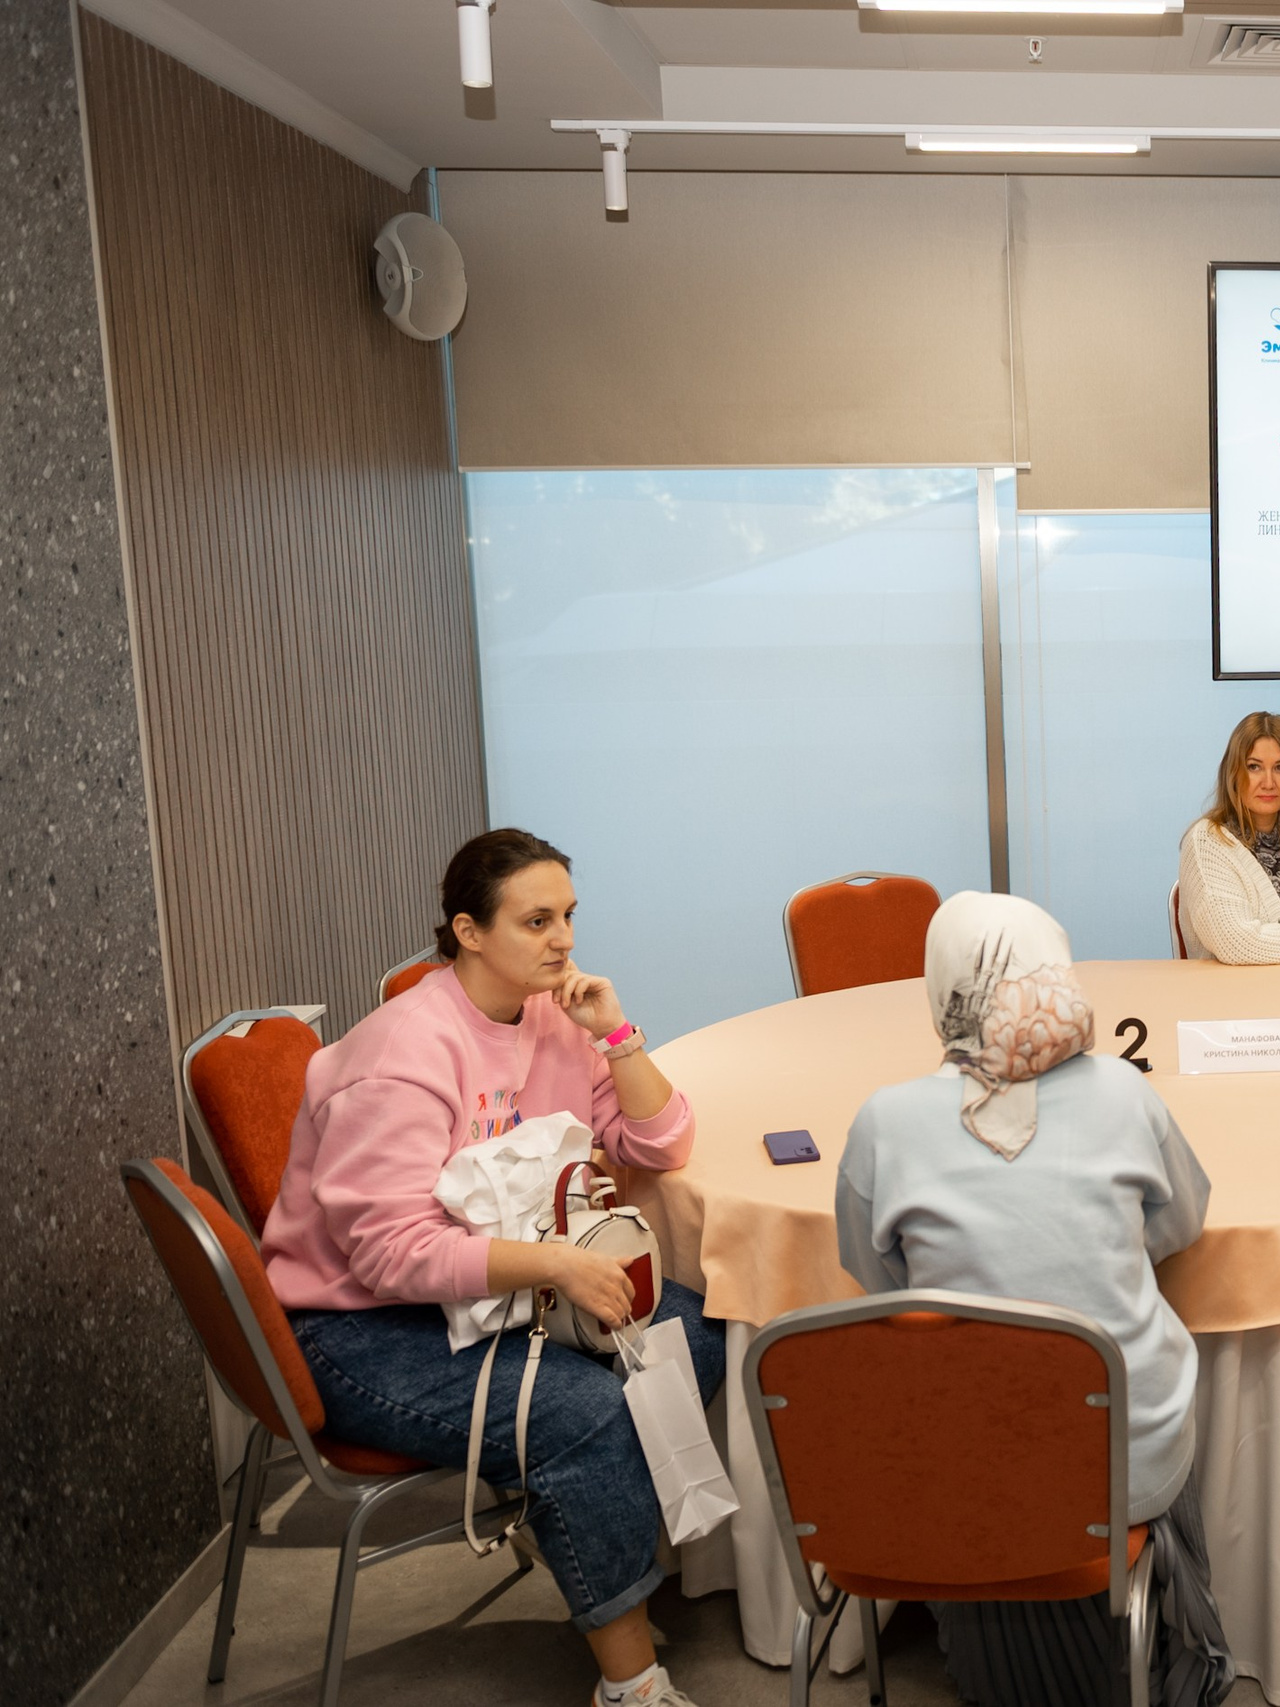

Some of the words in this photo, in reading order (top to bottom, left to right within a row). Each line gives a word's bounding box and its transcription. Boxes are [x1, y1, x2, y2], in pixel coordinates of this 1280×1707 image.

[1115, 1018, 1149, 1068] 2
[1231, 1035, 1280, 1043] МАНАФОВА
[1203, 1050, 1249, 1058] КРИСТИНА
